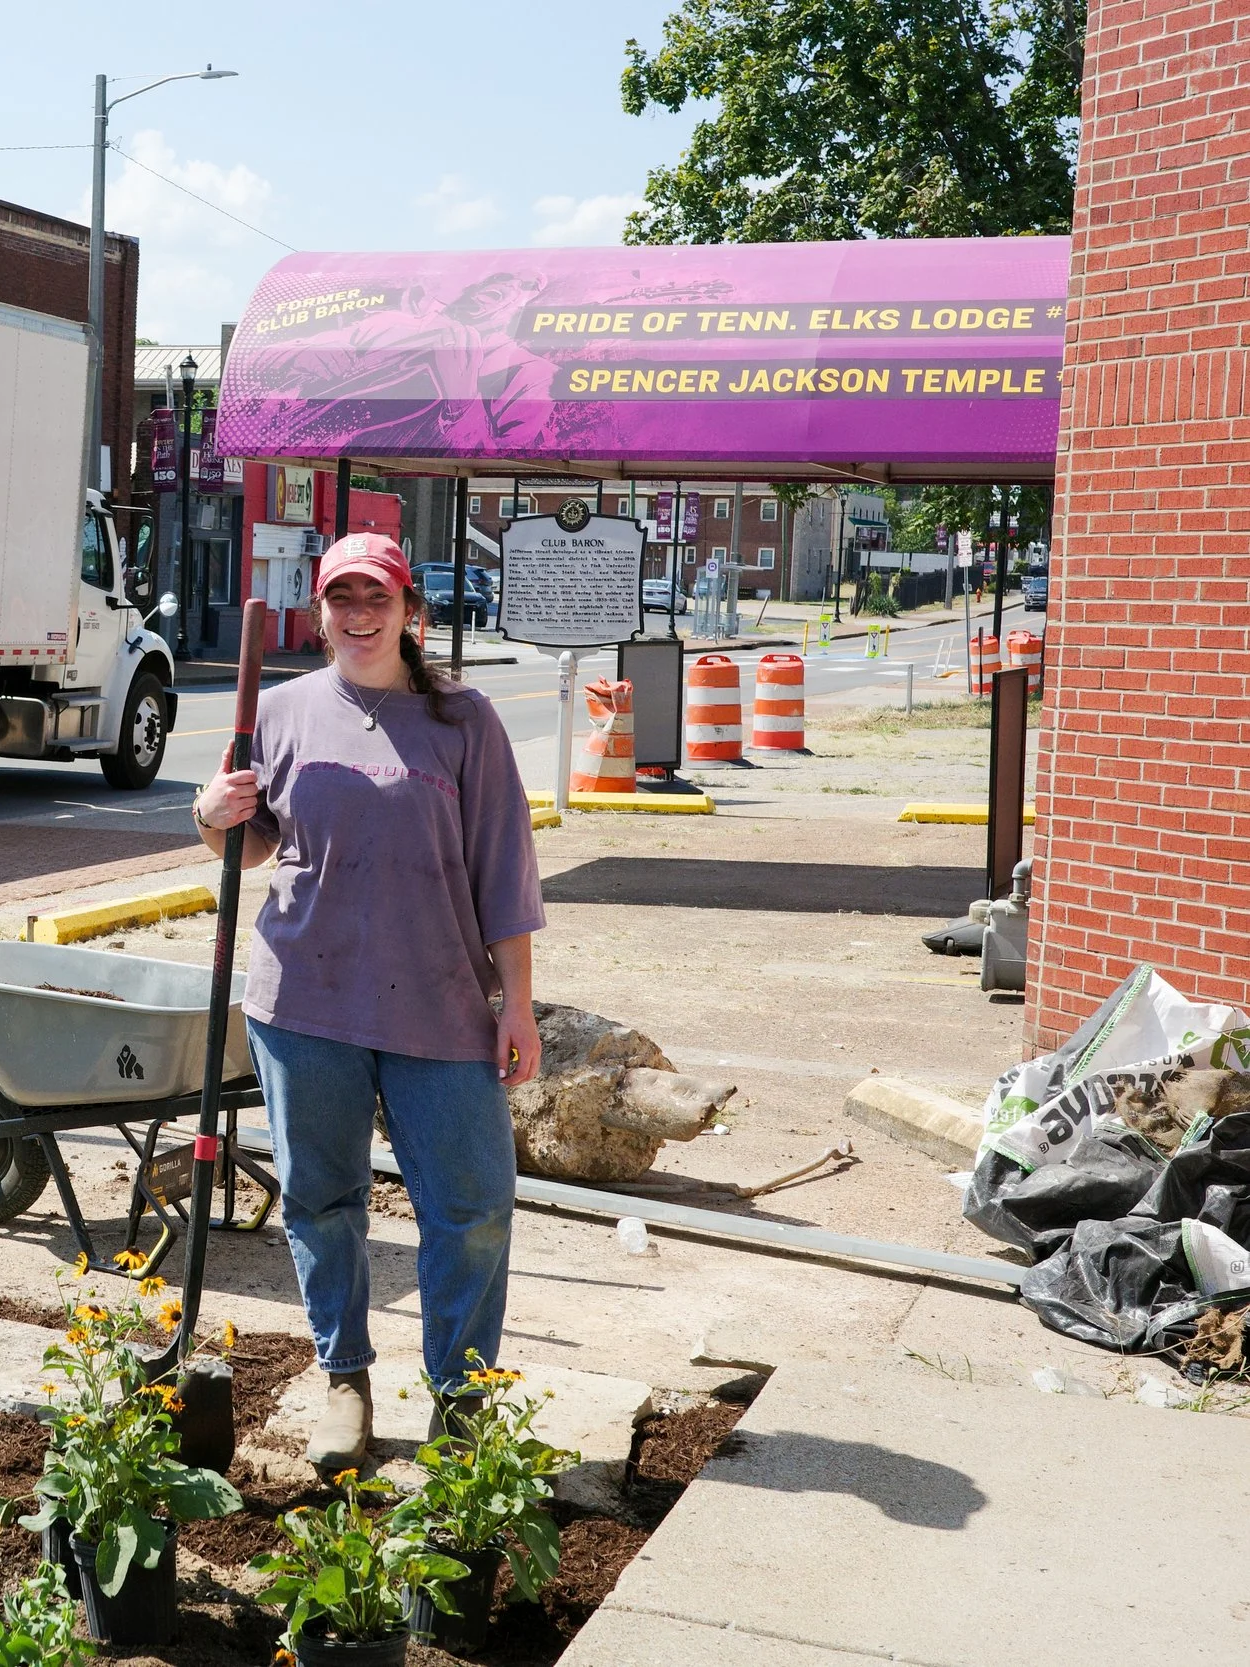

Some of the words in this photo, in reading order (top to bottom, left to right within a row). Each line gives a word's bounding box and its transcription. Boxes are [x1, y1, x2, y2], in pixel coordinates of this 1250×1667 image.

[255, 310, 309, 334] CLUB
[315, 294, 385, 320] BARON
[276, 288, 362, 315] FORMER
[532, 312, 634, 333] PRIDE
[641, 312, 688, 333] OF
[696, 310, 797, 332] TENN.
[809, 309, 901, 330] ELKS
[910, 307, 1035, 330] LODGE
[569, 368, 721, 393] SPENCER
[728, 368, 890, 393] JACKSON
[901, 369, 1046, 393] TEMPLE
[541, 539, 566, 547] CLUB
[572, 539, 605, 548] BARON
[159, 1159, 182, 1174] GORILLA
